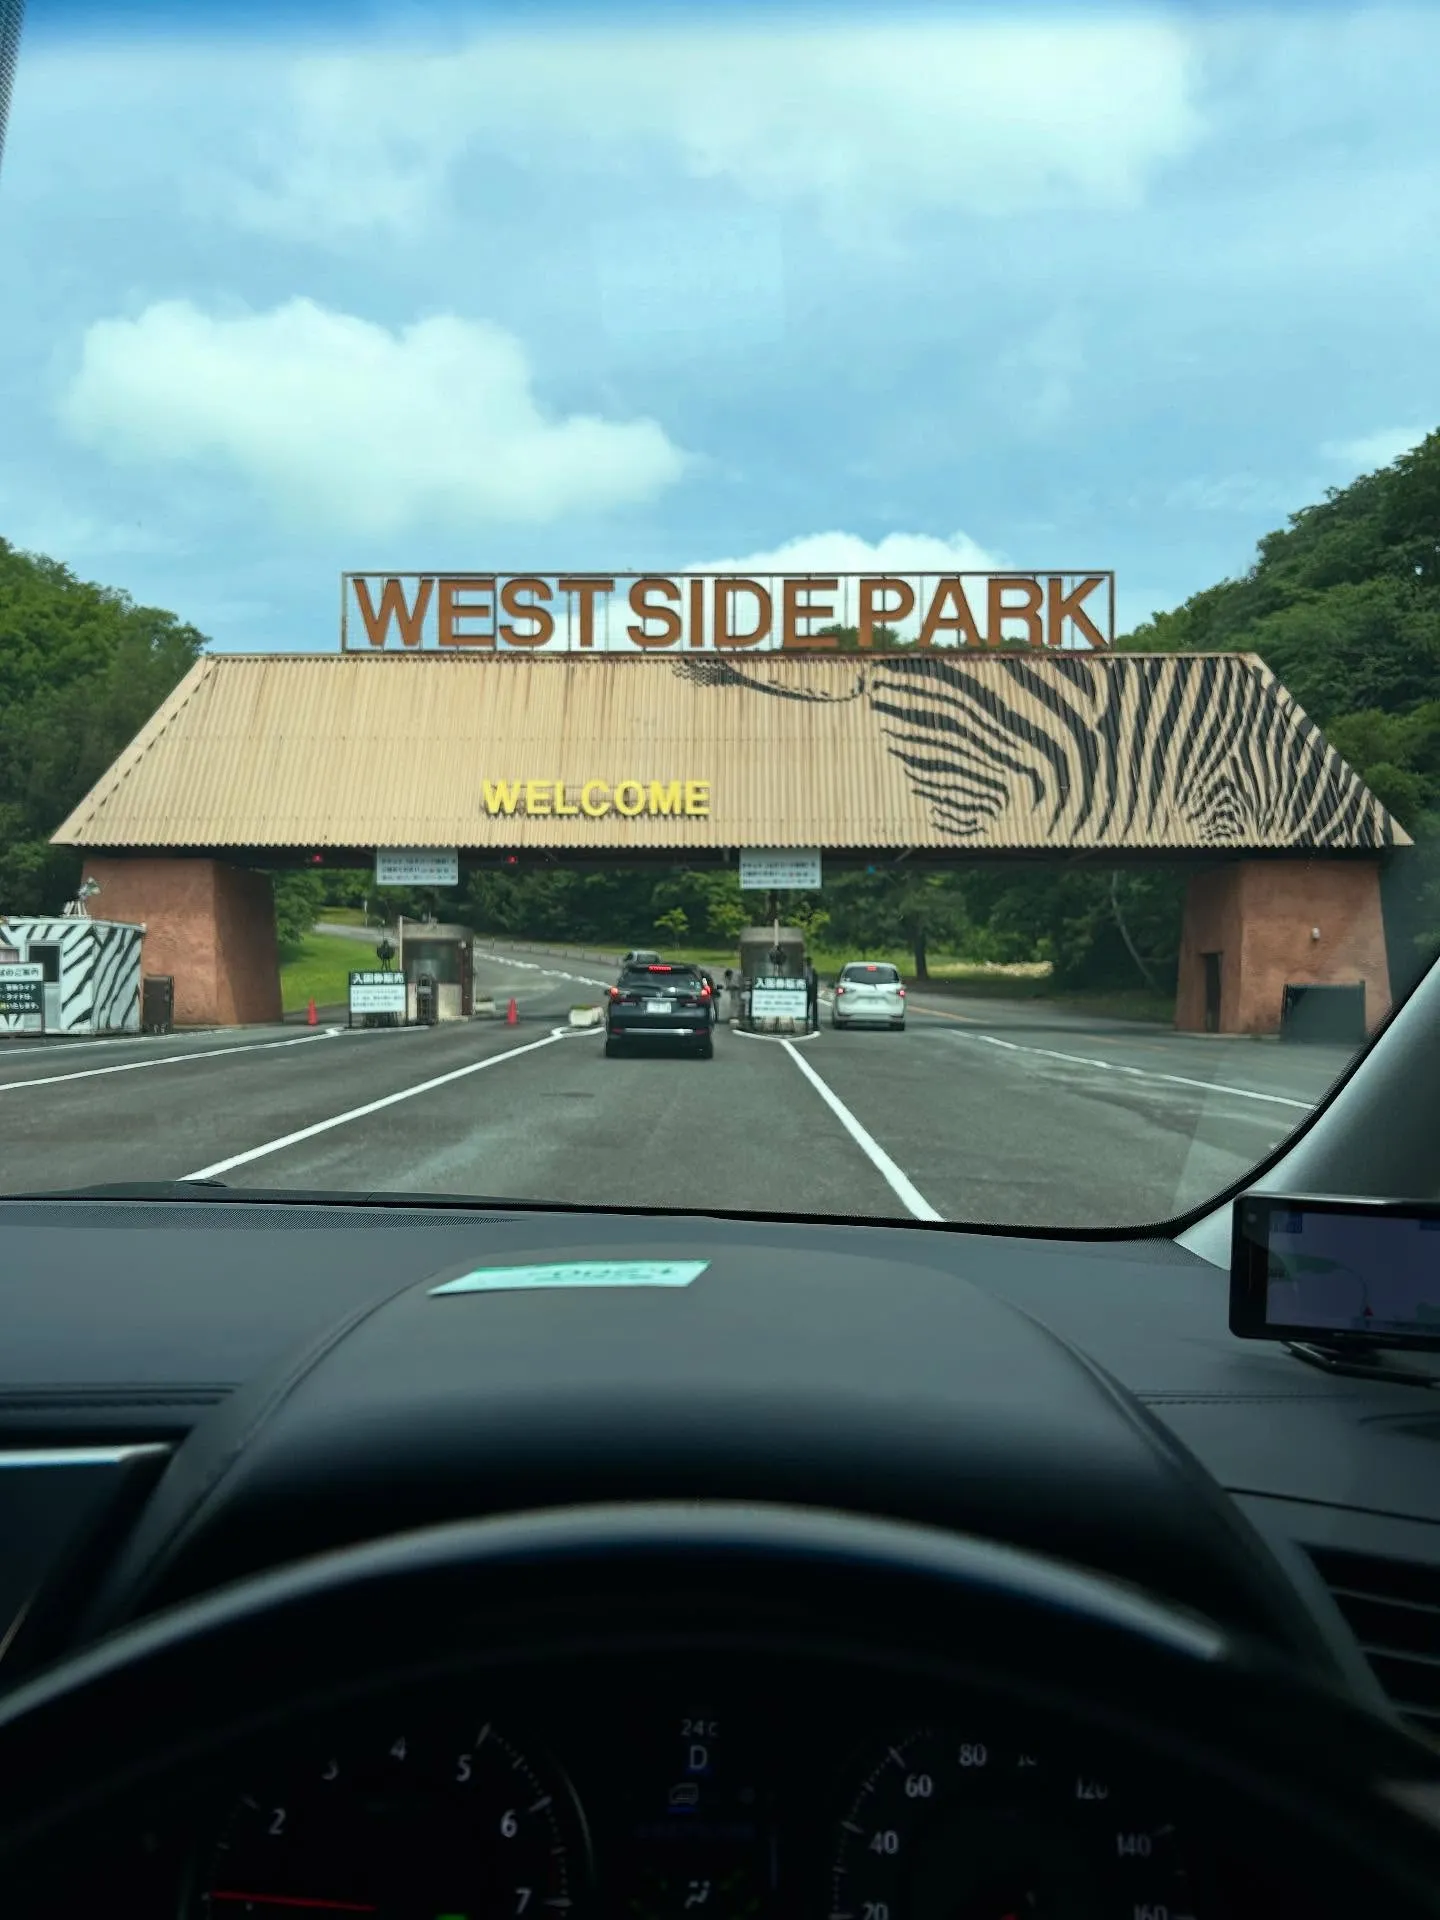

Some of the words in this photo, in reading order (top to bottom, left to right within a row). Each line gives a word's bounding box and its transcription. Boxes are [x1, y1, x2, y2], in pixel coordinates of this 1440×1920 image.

[353, 578, 615, 649] WEST
[627, 577, 841, 648] SIDE
[858, 576, 1107, 648] PARK
[482, 779, 712, 817] WELCOME
[389, 1735, 408, 1763] 4
[688, 1744, 709, 1771] D
[958, 1743, 988, 1768] 80
[455, 1753, 473, 1783] 5
[904, 1773, 933, 1799] 60
[267, 1806, 287, 1837] 2
[499, 1808, 520, 1839] 6
[868, 1830, 900, 1855] 40
[1116, 1830, 1152, 1859] 140
[514, 1886, 534, 1917] 7
